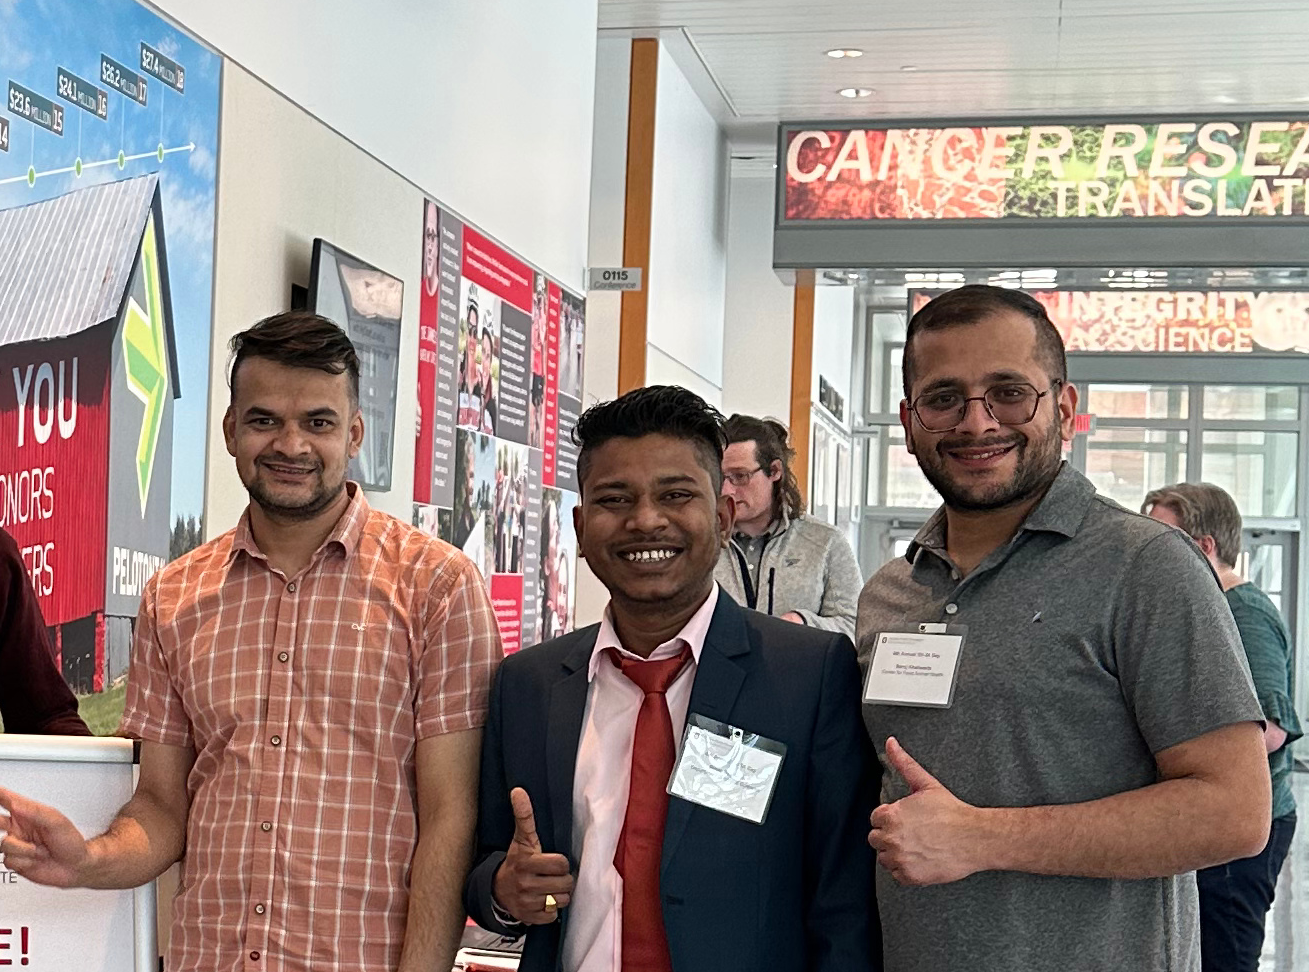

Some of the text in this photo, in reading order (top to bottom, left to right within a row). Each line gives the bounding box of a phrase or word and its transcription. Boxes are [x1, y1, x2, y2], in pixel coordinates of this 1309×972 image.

[10, 87, 31, 116] $23.6
[53, 109, 63, 132] 15
[787, 126, 1072, 183] CANCER
[12, 357, 79, 447] YOU
[112, 546, 166, 597] PELOTON
